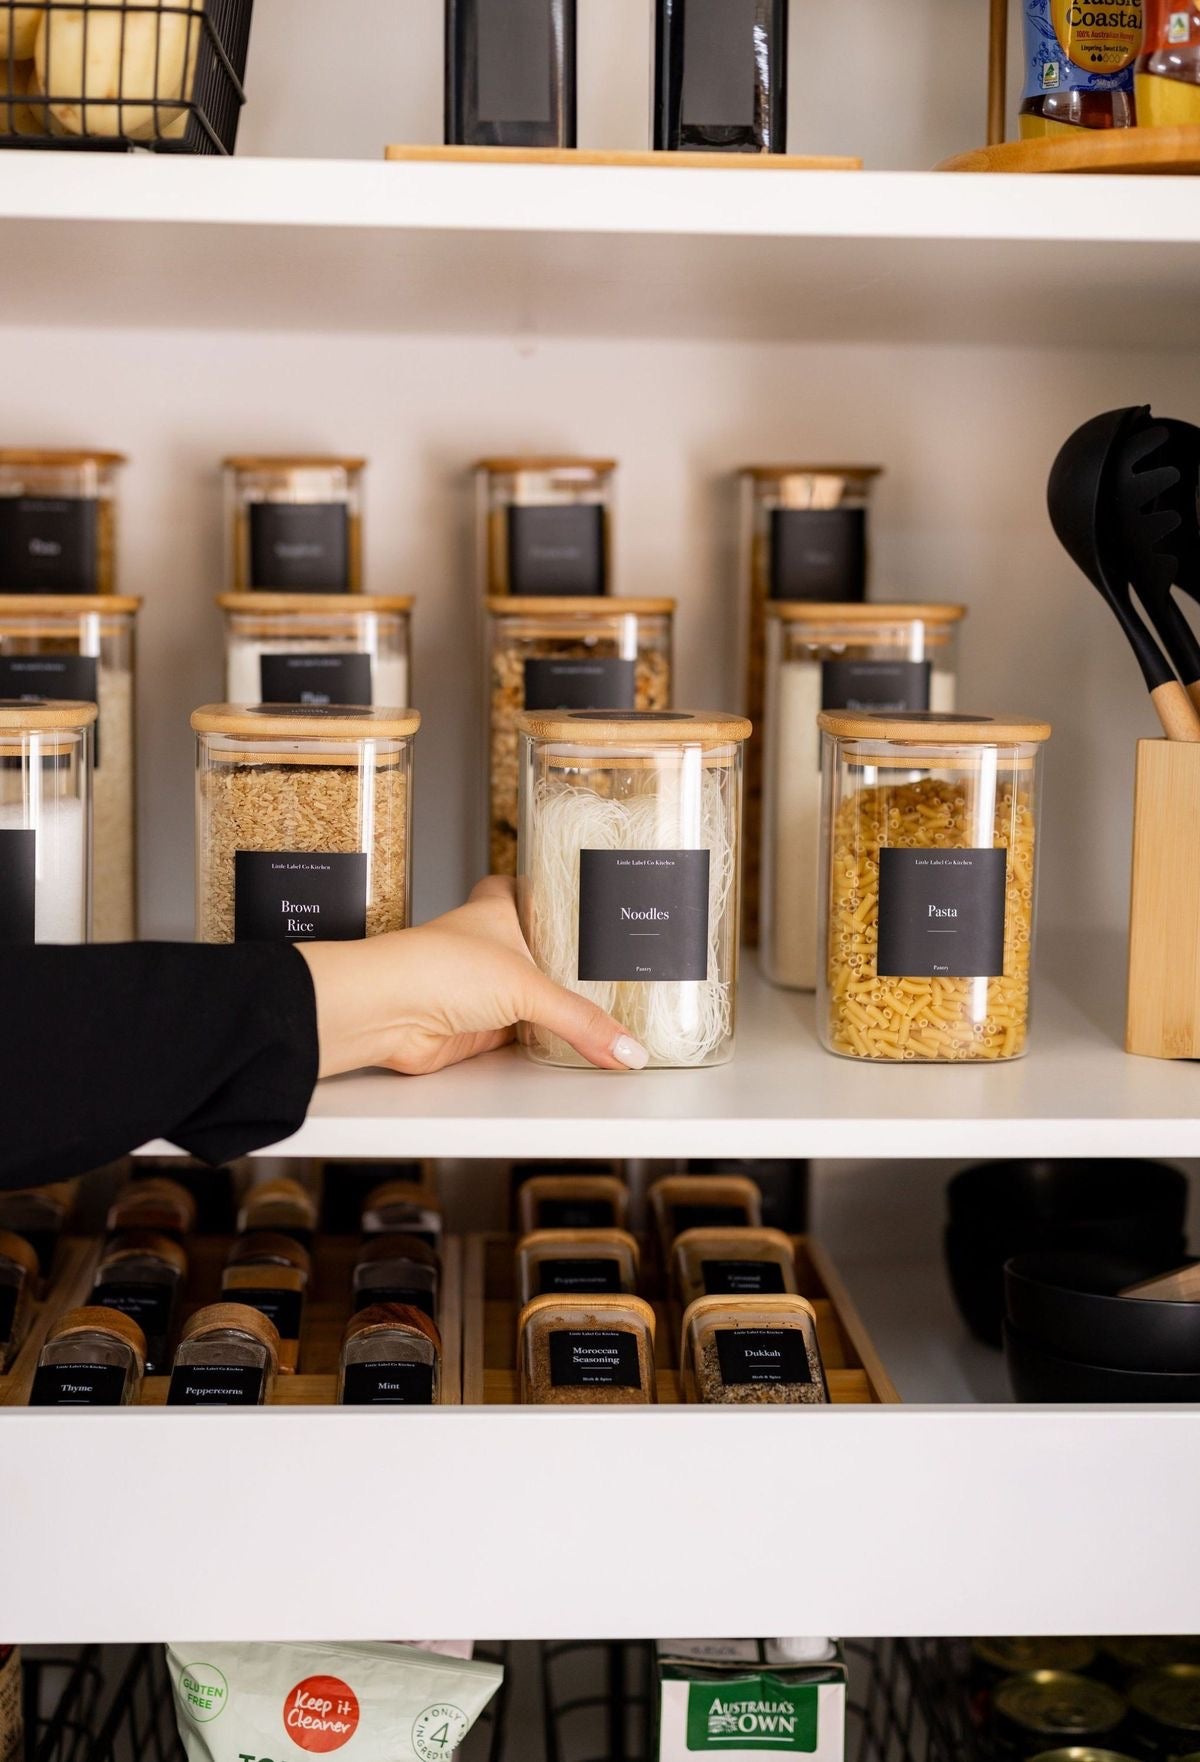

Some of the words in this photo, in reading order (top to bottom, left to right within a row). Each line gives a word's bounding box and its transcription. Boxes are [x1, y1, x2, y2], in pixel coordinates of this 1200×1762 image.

[1066, 7, 1142, 29] Coastal
[281, 900, 320, 913] Brown
[620, 907, 670, 920] Noodles
[927, 904, 958, 918] Pasta
[287, 919, 314, 932] Rice
[572, 1355, 620, 1365] Seasoning
[744, 1349, 781, 1357] Dukkah
[61, 1384, 93, 1393] Thyme
[185, 1387, 243, 1396] Peppercorns
[378, 1382, 400, 1390] Mint
[183, 1678, 224, 1698] GLUTEN
[187, 1693, 213, 1710] FREE
[294, 1689, 332, 1717] Keep
[337, 1700, 352, 1716] it
[287, 1708, 351, 1734] Cleaner
[431, 1707, 462, 1721] ONLY
[738, 1713, 796, 1734] OWN
[430, 1722, 449, 1749] 4
